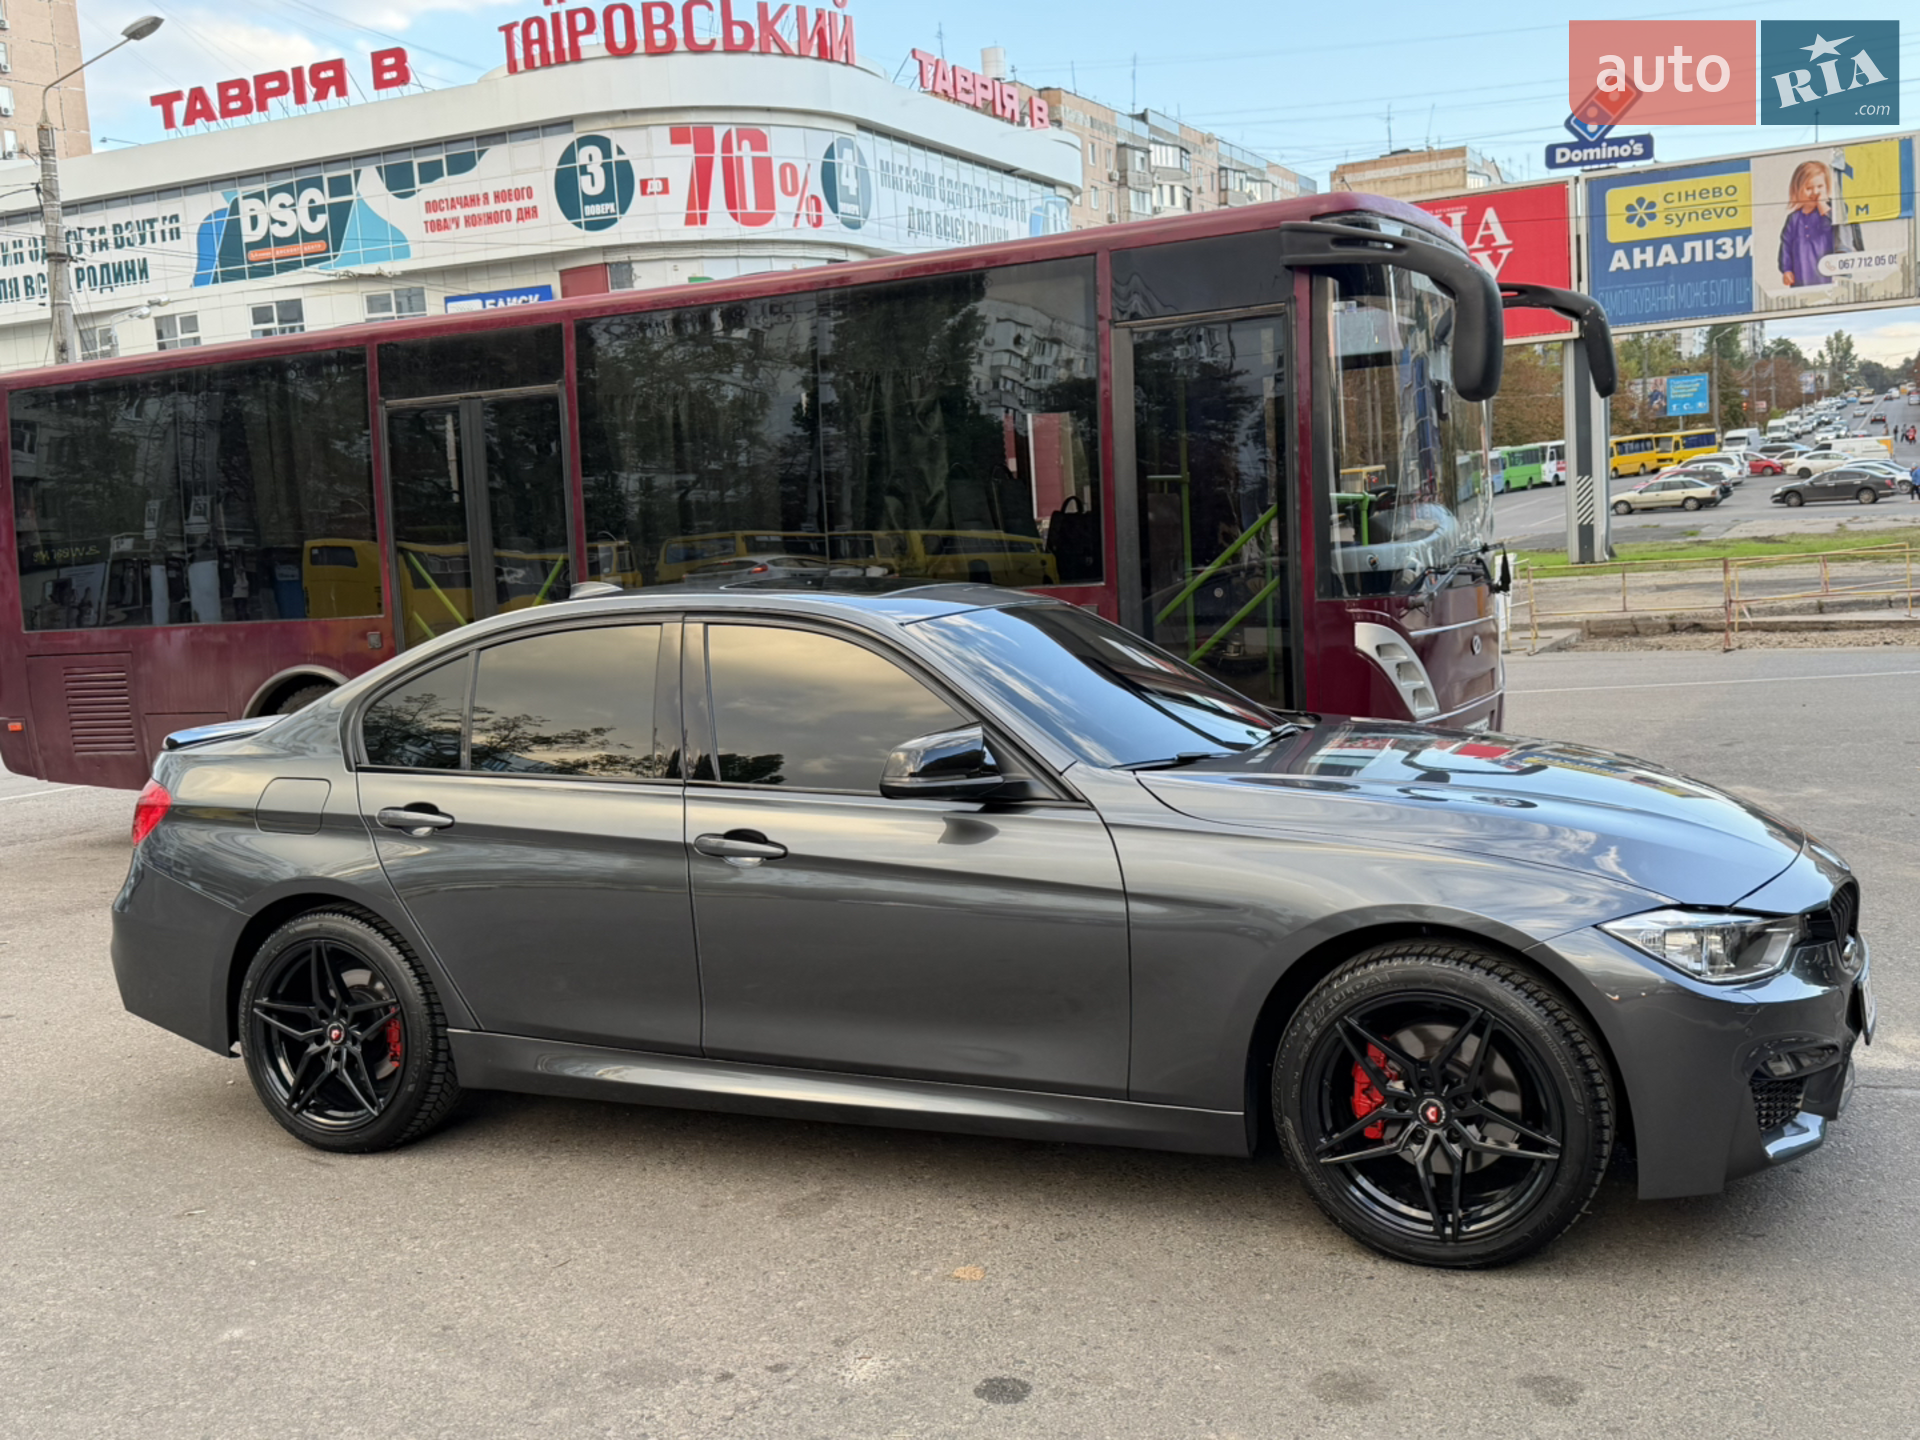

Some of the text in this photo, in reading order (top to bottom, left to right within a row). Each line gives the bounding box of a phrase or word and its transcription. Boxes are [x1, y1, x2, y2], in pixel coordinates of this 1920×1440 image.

[498, 0, 856, 75] ТАЇРОВСЬКИЙ
[150, 47, 412, 130] ТАВРІЯ В
[911, 48, 1051, 129] ТАВРІЯ В
[1555, 139, 1645, 164] Domino's
[579, 145, 606, 196] 3
[841, 147, 858, 196] 4
[241, 187, 327, 243] DSC
[424, 186, 534, 214] ПОСТАЧАННЯ НОВОГО
[516, 205, 539, 223] ДНЯ
[584, 202, 616, 216] ПОВЕРХ
[1663, 206, 1739, 229] synevo
[112, 213, 181, 250] ВЗУТТЯ
[1609, 234, 1753, 272] АНАЛІЗИ
[1838, 258, 1854, 270] 067
[1857, 256, 1873, 268] 712
[1874, 255, 1886, 266] 05
[75, 257, 150, 294] РОДИНИ
